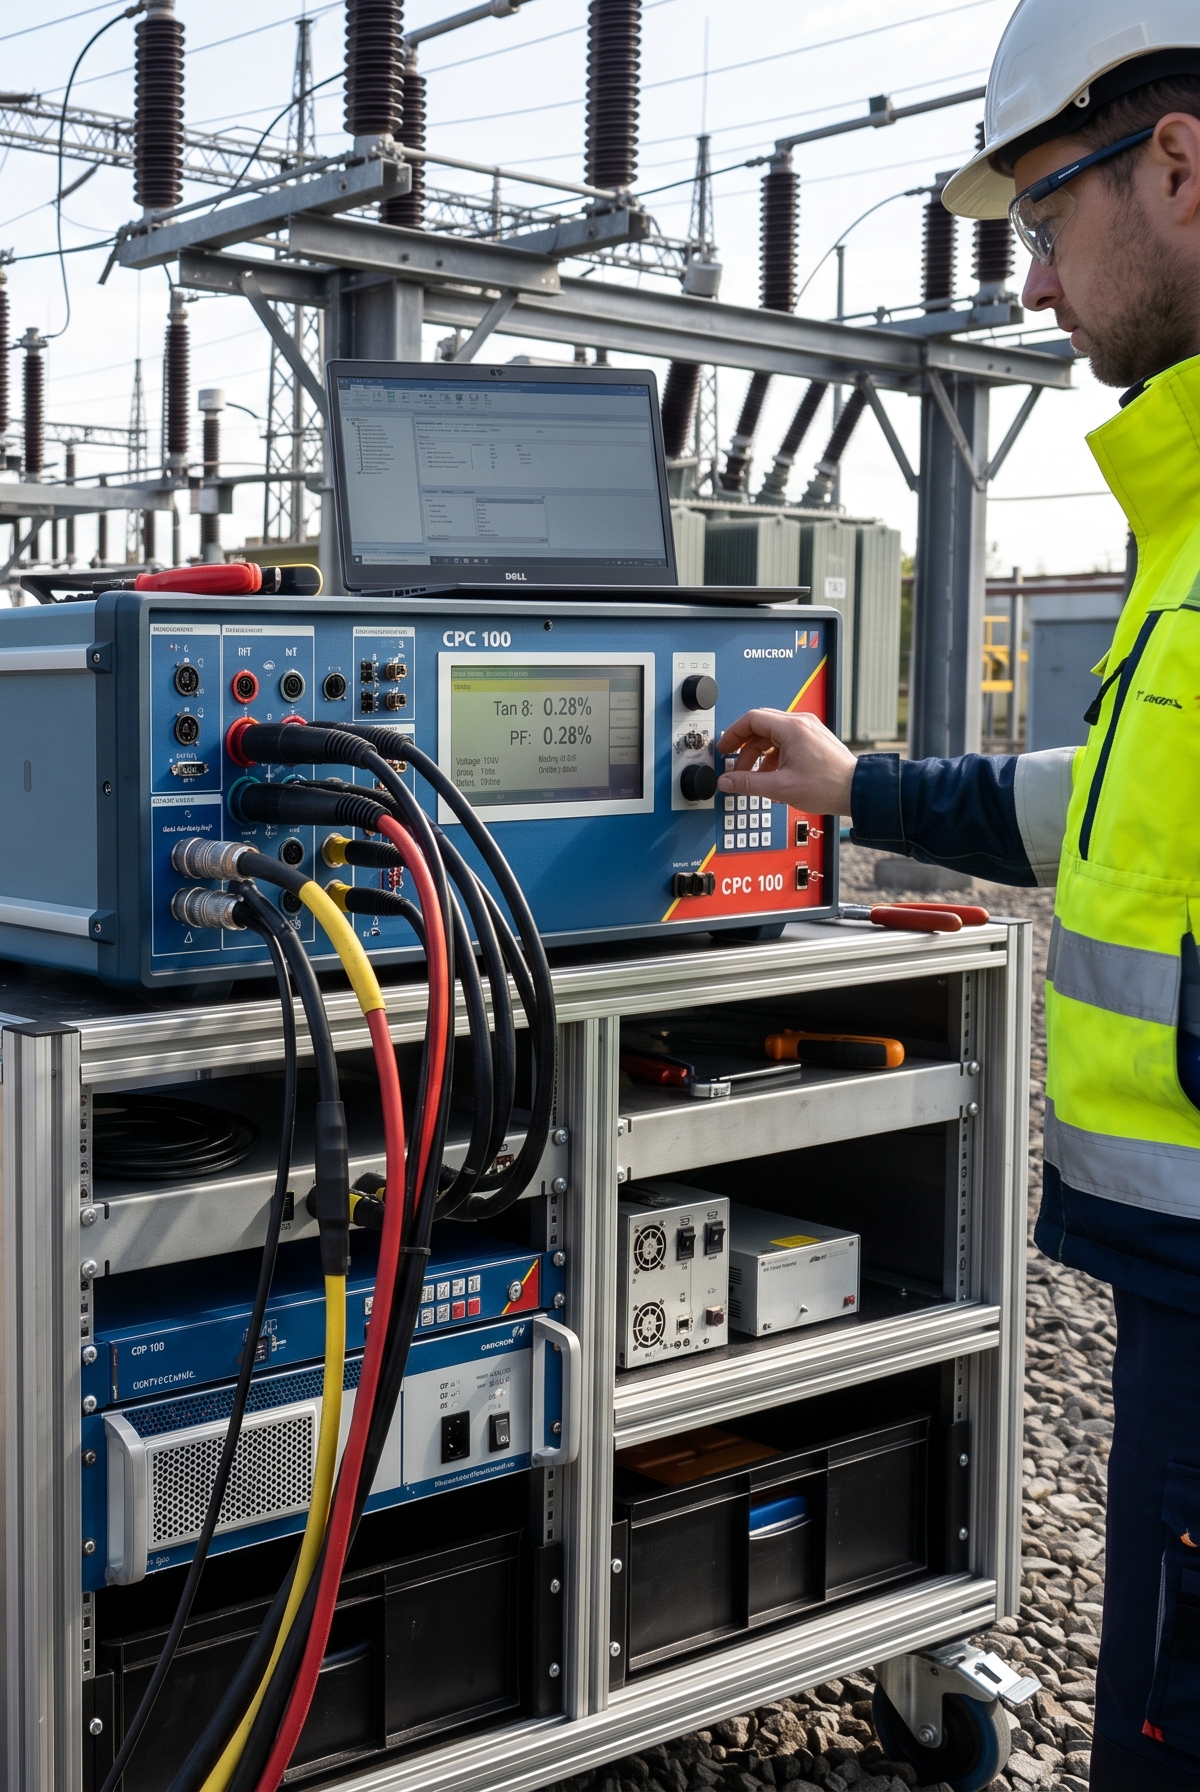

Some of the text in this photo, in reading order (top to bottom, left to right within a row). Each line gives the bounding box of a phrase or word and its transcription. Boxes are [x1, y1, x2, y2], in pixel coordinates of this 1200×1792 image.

[442, 630, 512, 648] CPC 100
[743, 648, 794, 659] OMICRON
[493, 700, 517, 716] Tan
[543, 696, 592, 716] 0.28%
[510, 725, 592, 746] PF: 0.28%
[721, 873, 784, 895] CPC 100
[480, 1338, 514, 1351] OMICRON
